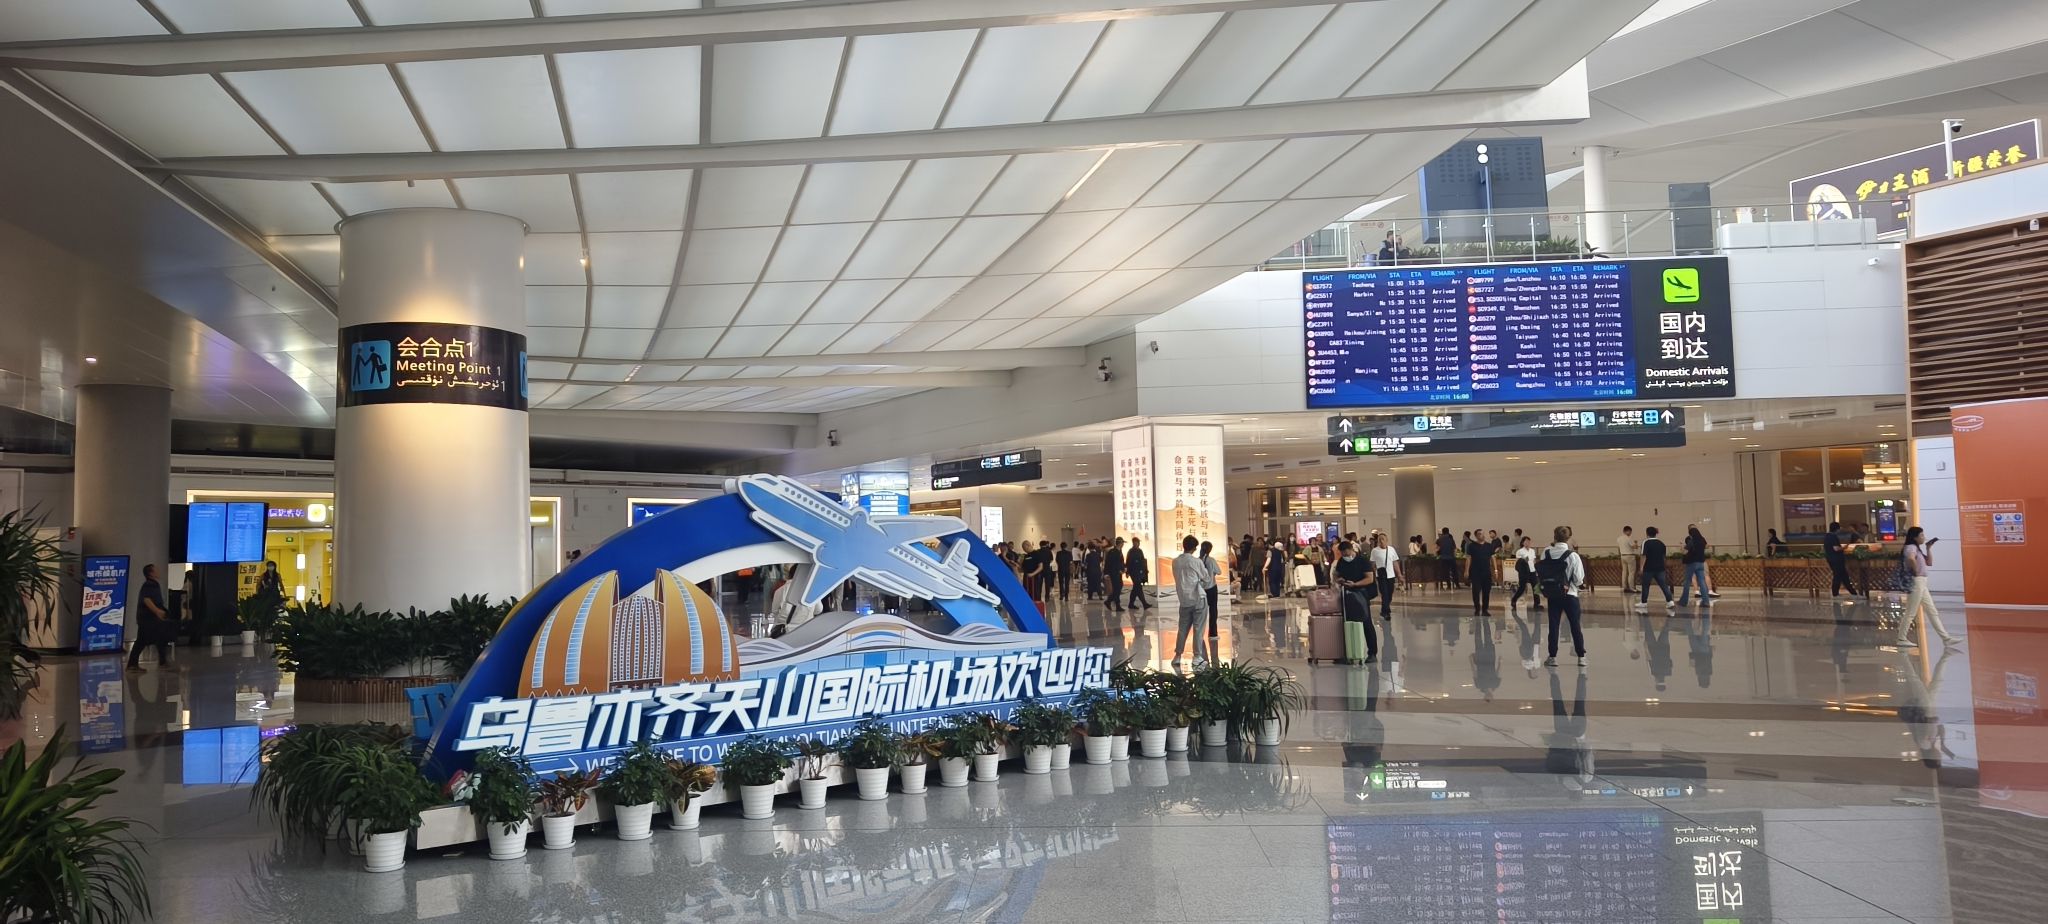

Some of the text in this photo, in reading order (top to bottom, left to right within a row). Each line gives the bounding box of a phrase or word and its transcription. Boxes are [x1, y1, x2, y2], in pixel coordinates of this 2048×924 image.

[1660, 311, 1705, 334] 国内
[398, 336, 474, 358] 会合点1
[1661, 337, 1709, 359] 到达
[397, 360, 501, 376] Meeting Point 1
[1646, 366, 1728, 377] Domestic Arrivals
[455, 647, 1113, 757] 乌鲁木齐天山国际机场欢迎您
[689, 744, 712, 763] TO
